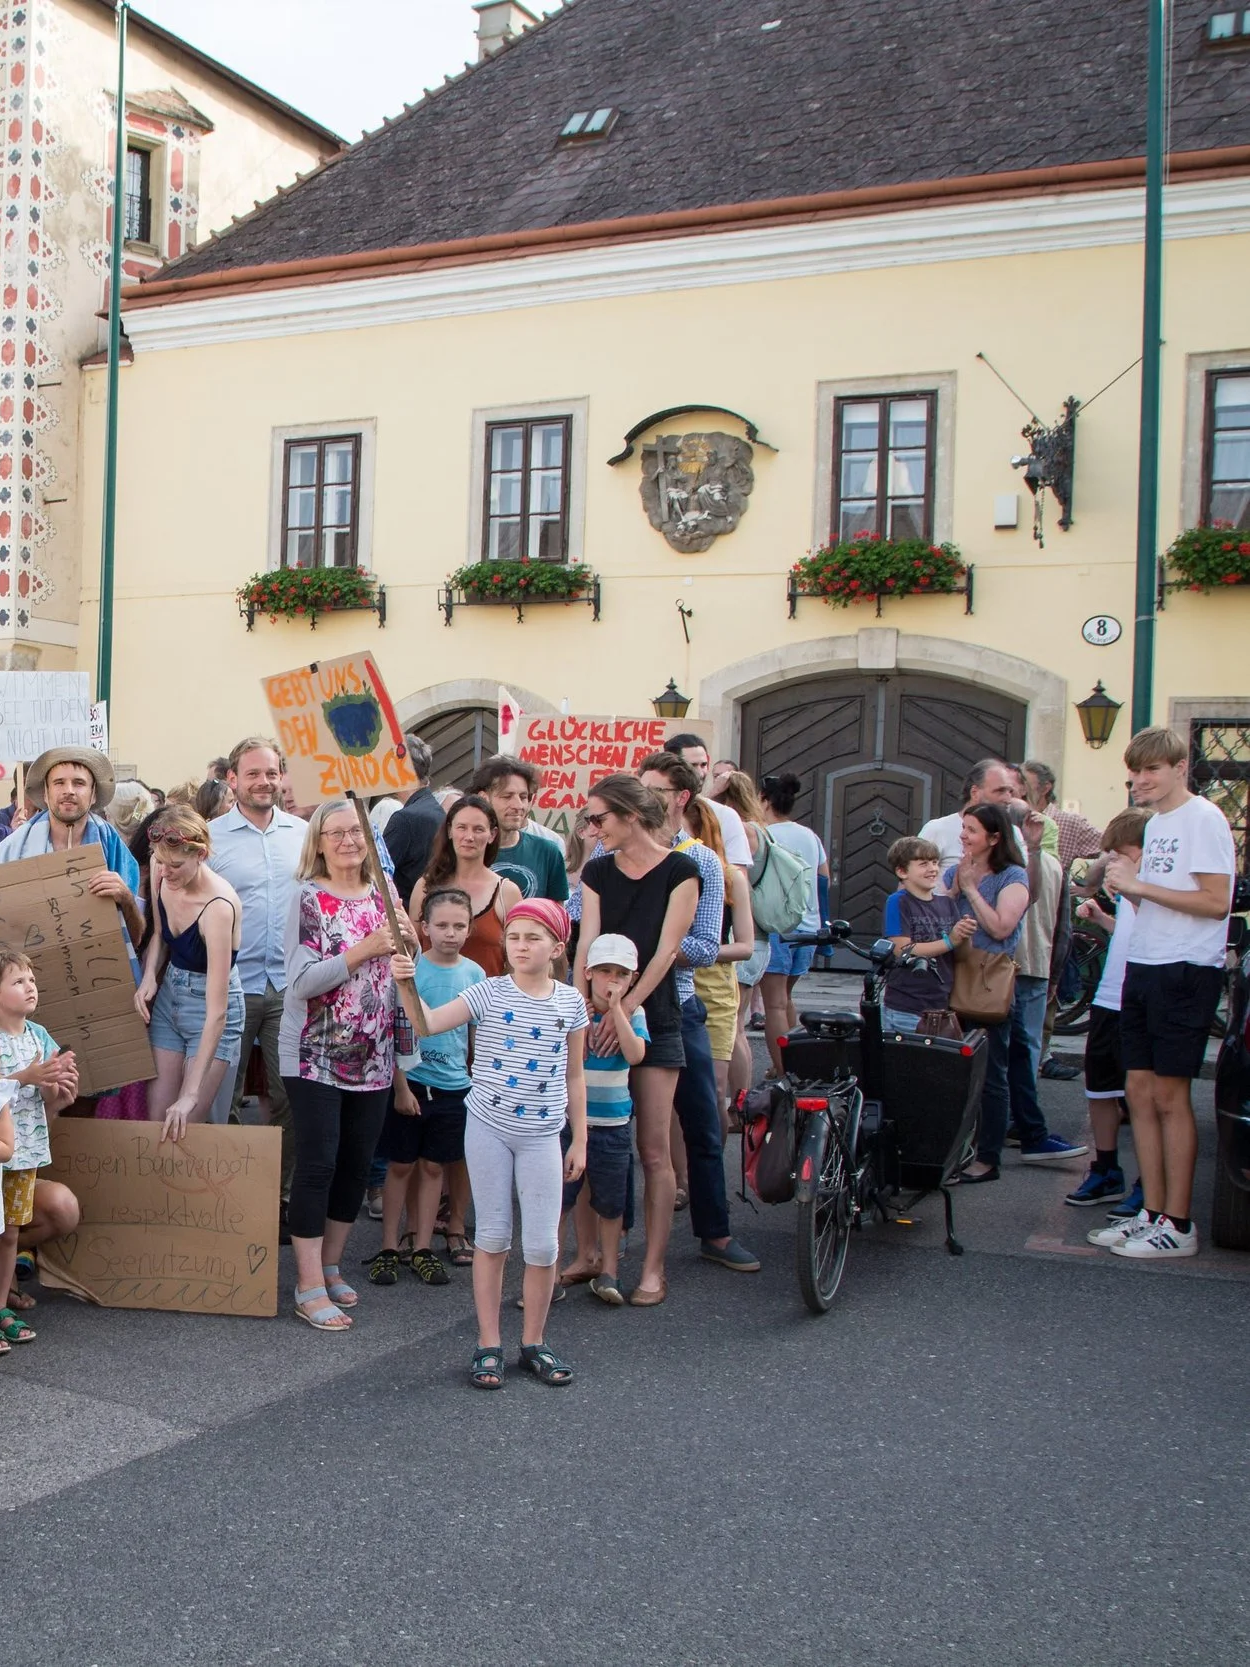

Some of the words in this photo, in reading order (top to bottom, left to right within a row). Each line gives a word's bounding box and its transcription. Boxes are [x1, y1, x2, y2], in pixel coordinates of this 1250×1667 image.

[1097, 619, 1107, 636] 8
[266, 667, 317, 709] GEBT
[318, 662, 362, 700] UNS
[29, 699, 56, 724] TUT
[60, 698, 88, 722] DEN
[527, 716, 667, 747] GLÜCKLICHE
[7, 727, 49, 756] NICHT
[279, 711, 318, 757] DEN
[519, 743, 627, 768] MENSCHEN
[65, 856, 96, 899] Ich
[46, 896, 81, 997] schwimmen
[76, 1012, 95, 1042] in
[79, 917, 123, 989] will
[50, 1133, 128, 1190] Gegen
[131, 1136, 256, 1178] Badeverbot
[111, 1192, 245, 1236] respektvolle
[85, 1236, 237, 1291] Seenutzung
